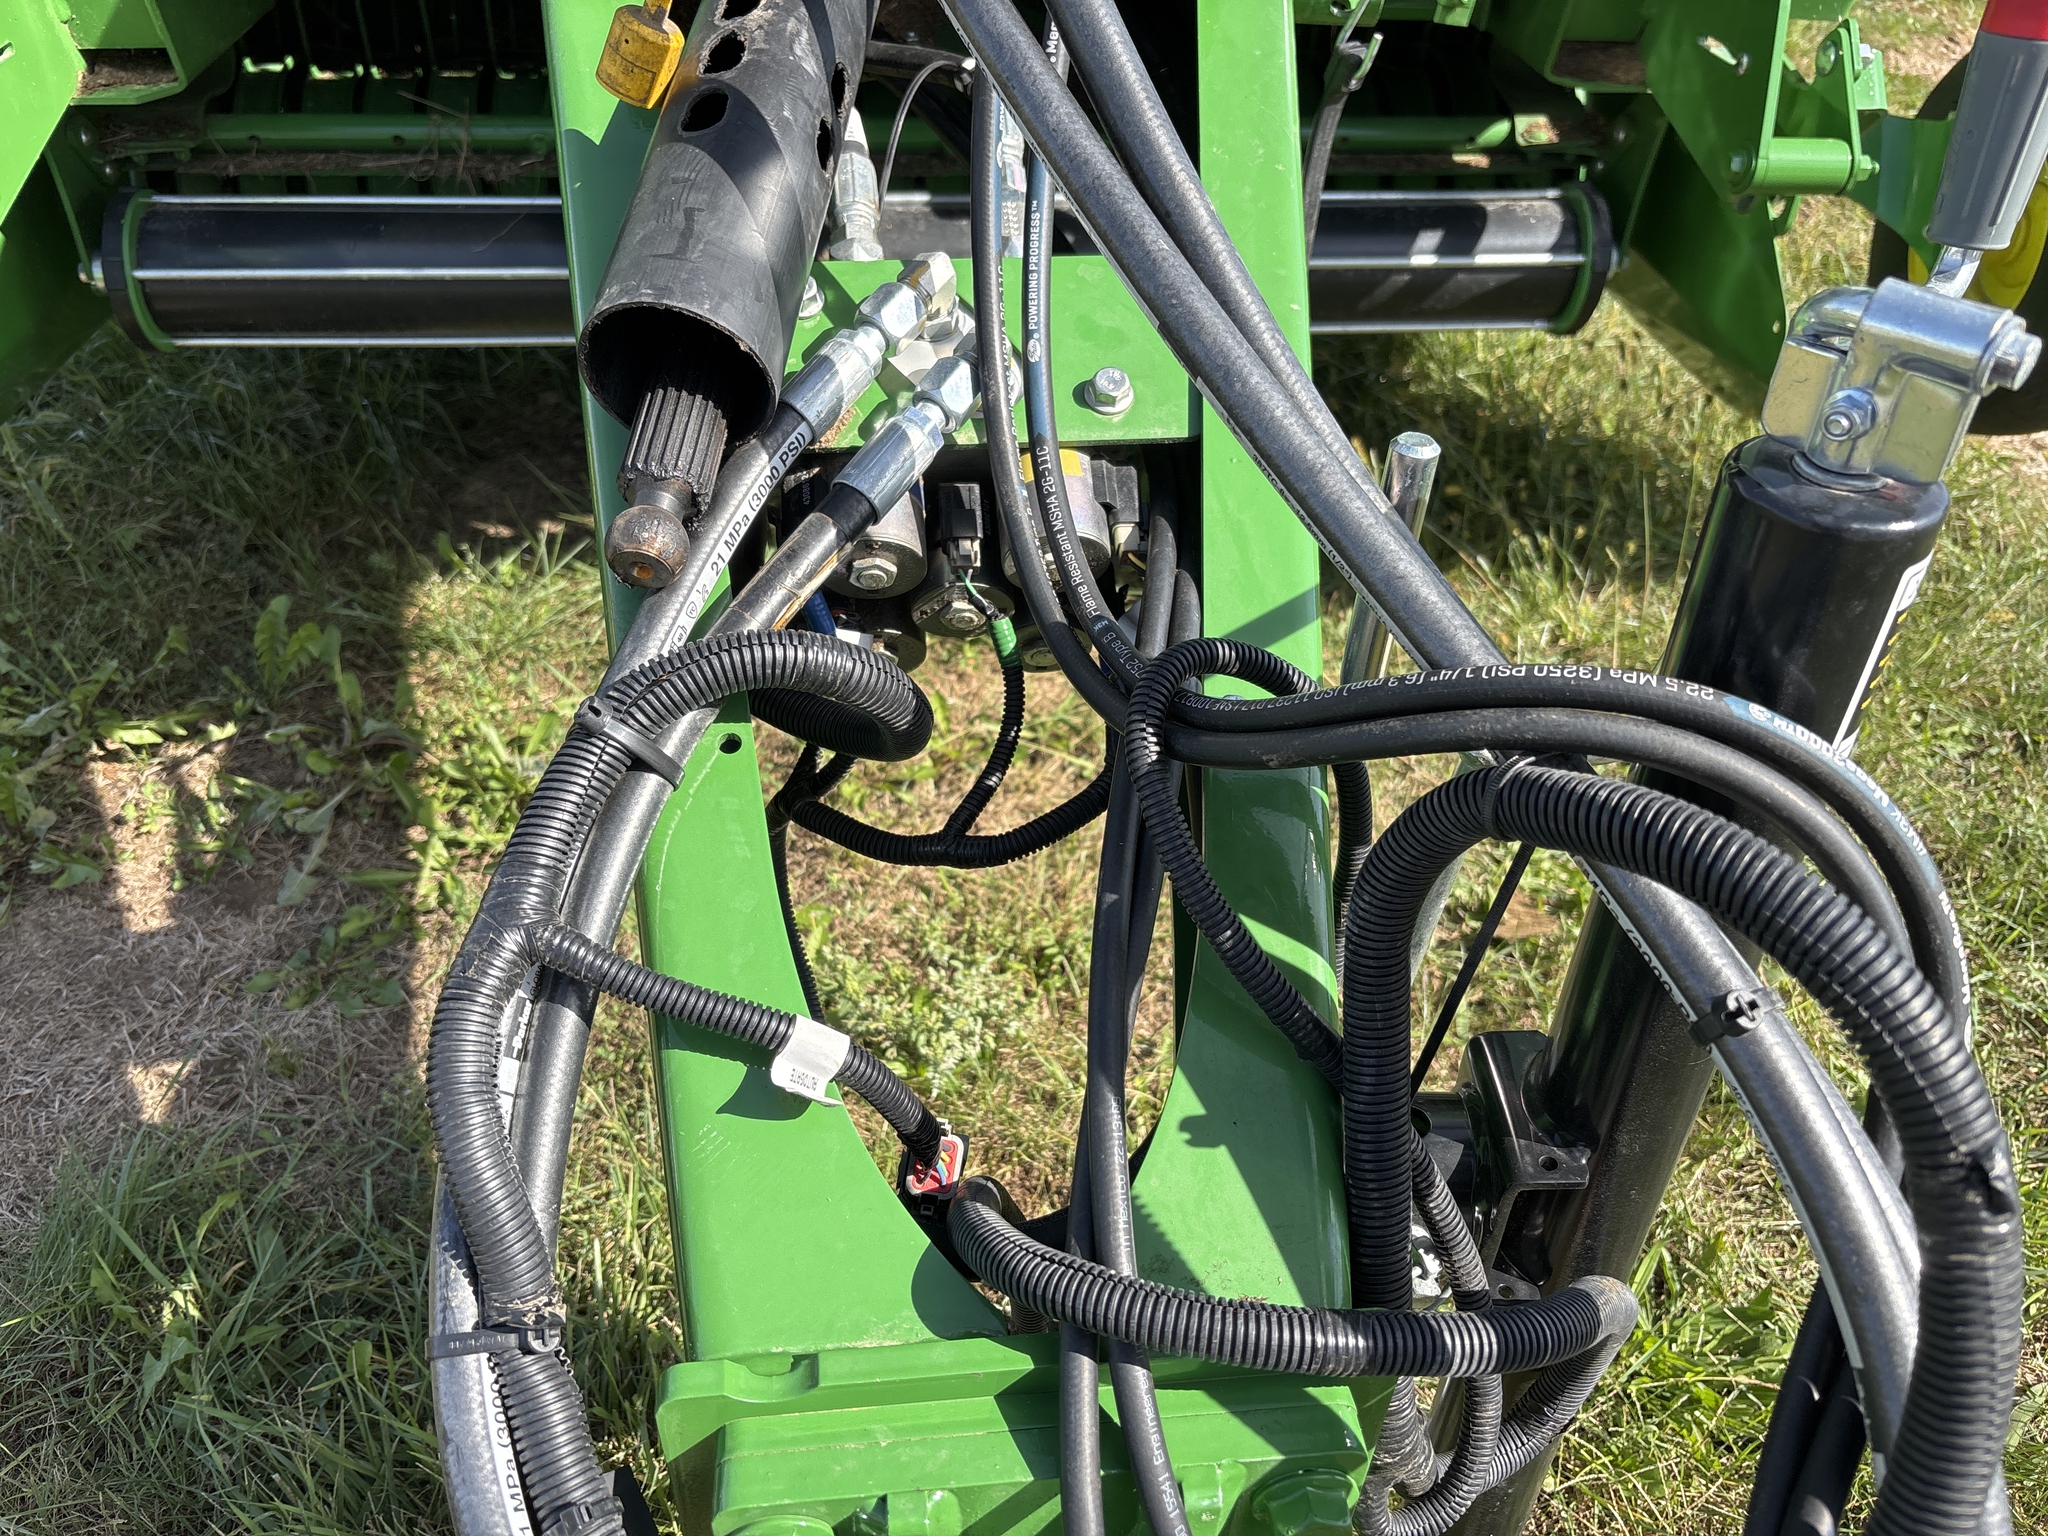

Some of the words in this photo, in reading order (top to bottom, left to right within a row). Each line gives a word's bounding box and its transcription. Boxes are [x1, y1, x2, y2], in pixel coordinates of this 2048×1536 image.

[1028, 273, 1041, 330] POWERING
[1036, 444, 1056, 494] 2G-11C
[710, 555, 727, 577] 21
[725, 513, 751, 552] MPa
[748, 465, 781, 512] (3000
[781, 431, 807, 469] PSI)
[1046, 494, 1065, 532] MSHA
[1054, 533, 1084, 586] Resistant
[1077, 577, 1101, 619] Flame
[1102, 631, 1117, 645] B
[1111, 641, 1133, 665] Type
[1482, 666, 1526, 680] PSI)
[1533, 664, 1602, 681] (3250
[1609, 668, 1658, 688] MPa
[1664, 676, 1715, 701] 22.5
[1117, 1175, 1130, 1229] Mexico
[1136, 1368, 1165, 1466] Engineered
[506, 1458, 526, 1514] MPa
[1157, 1471, 1181, 1519] 15541
